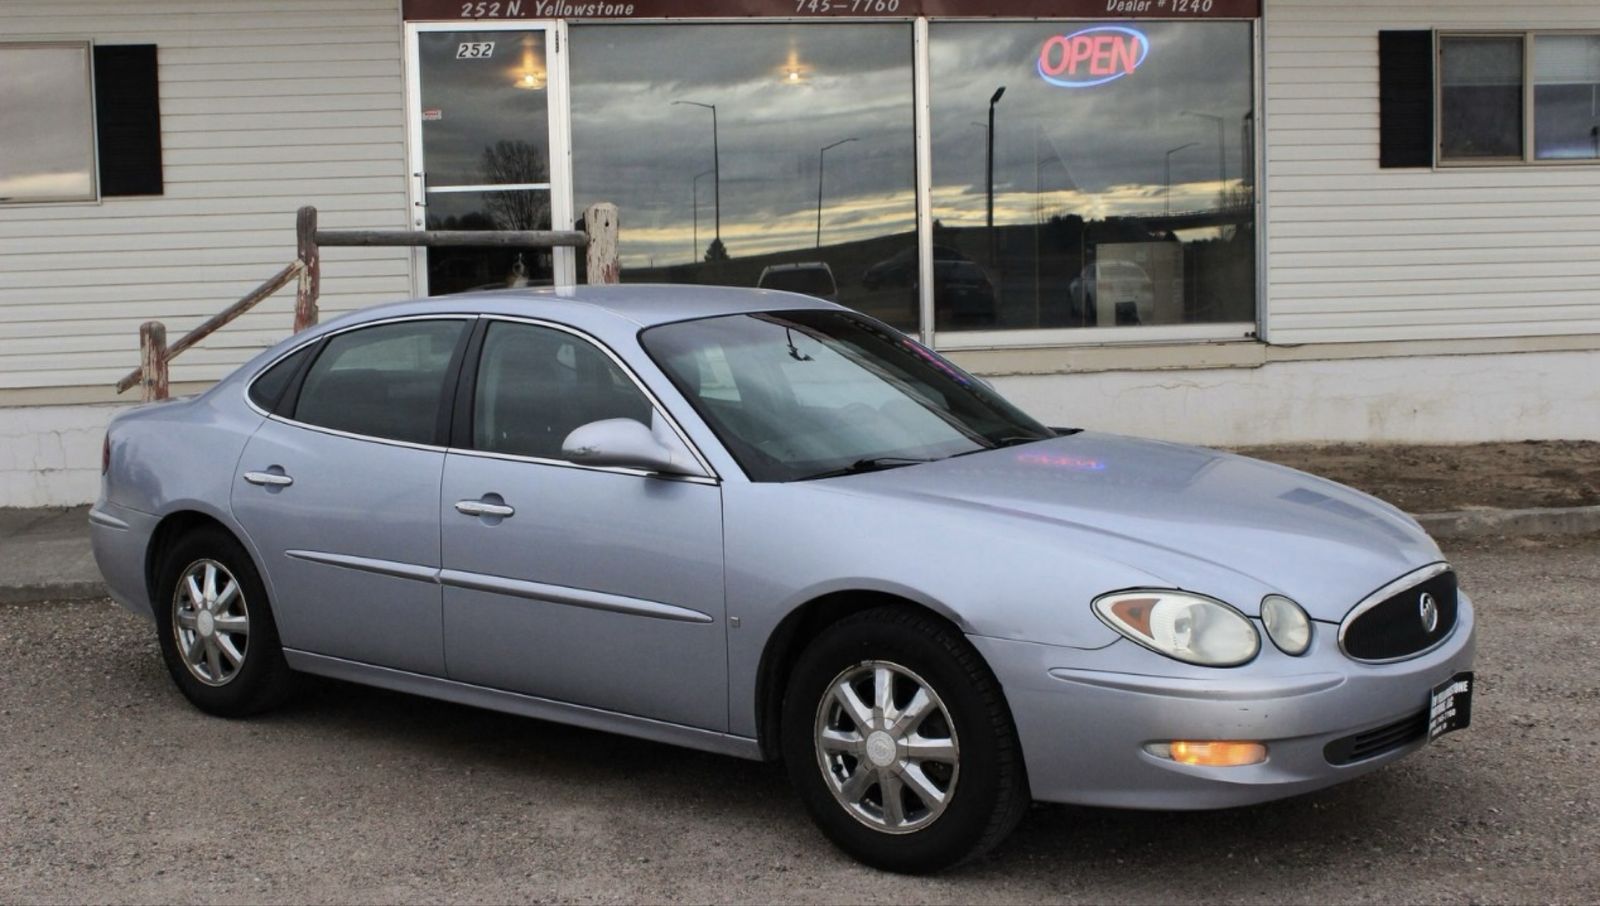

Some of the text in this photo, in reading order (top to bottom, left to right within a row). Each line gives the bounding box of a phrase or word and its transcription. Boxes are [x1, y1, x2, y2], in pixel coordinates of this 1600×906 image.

[461, 2, 635, 17] 252 N. Yellowstone
[1106, 0, 1151, 12] Dealer
[457, 43, 493, 58] 252
[1041, 35, 1139, 76] OPEN
